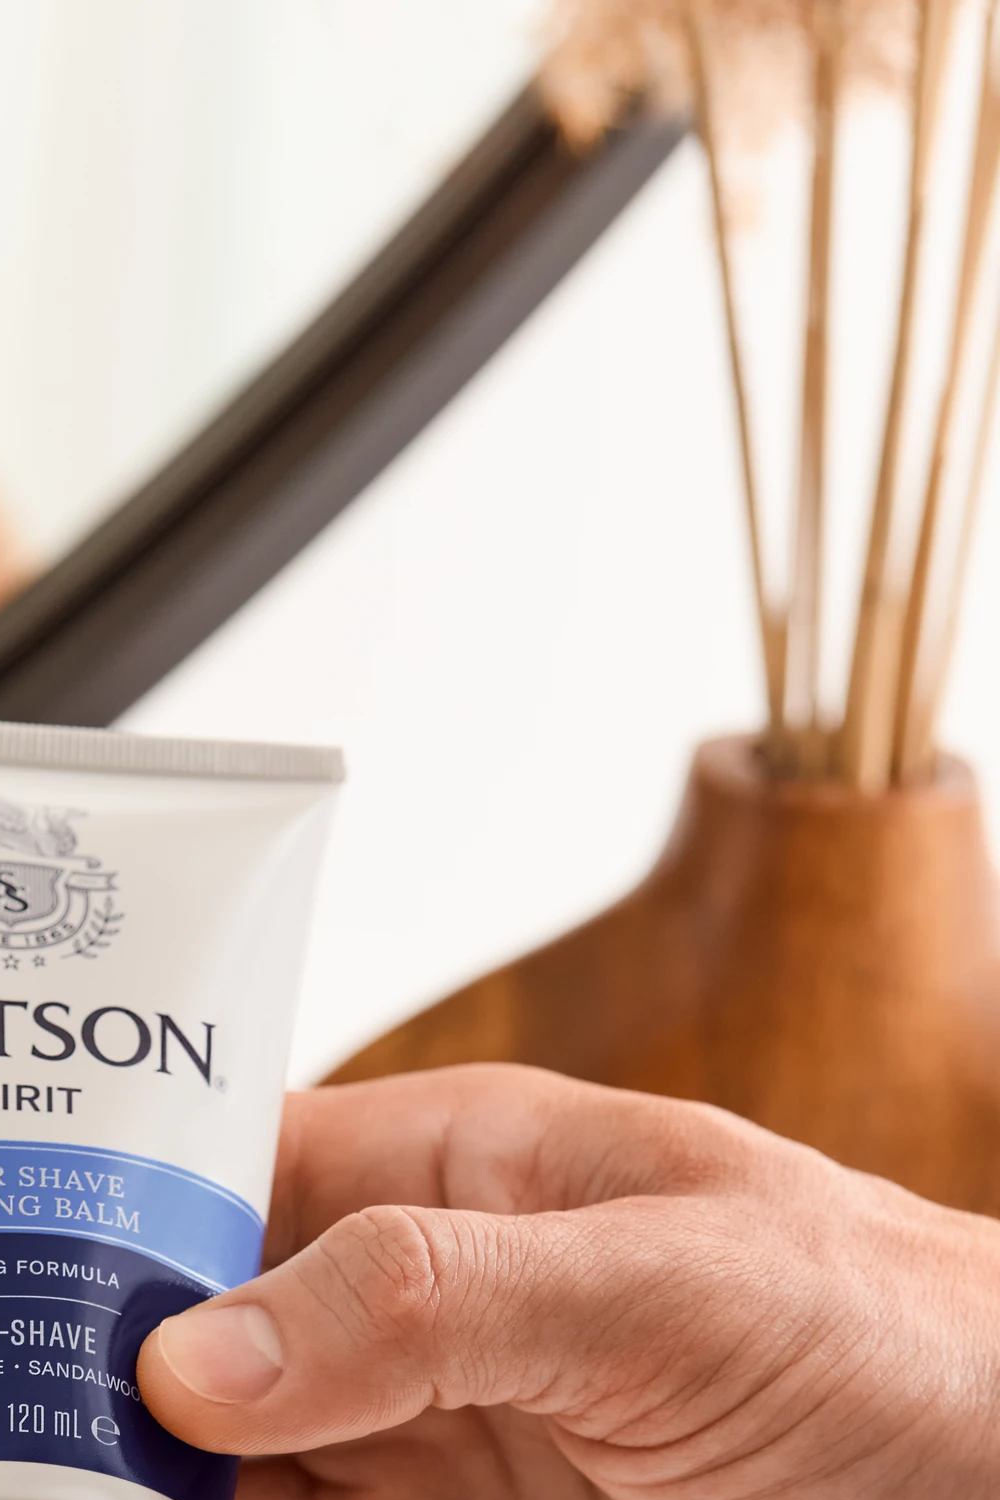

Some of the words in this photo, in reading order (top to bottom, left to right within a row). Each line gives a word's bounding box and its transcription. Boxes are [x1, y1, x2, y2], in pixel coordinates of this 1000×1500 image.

[18, 1166, 126, 1199] SHAVE
[54, 1196, 142, 1234] BALM
[16, 1259, 120, 1290] FORMULA
[27, 1359, 145, 1405] SANDALWOO
[6, 1402, 46, 1435] 120
[53, 1408, 83, 1441] mL
